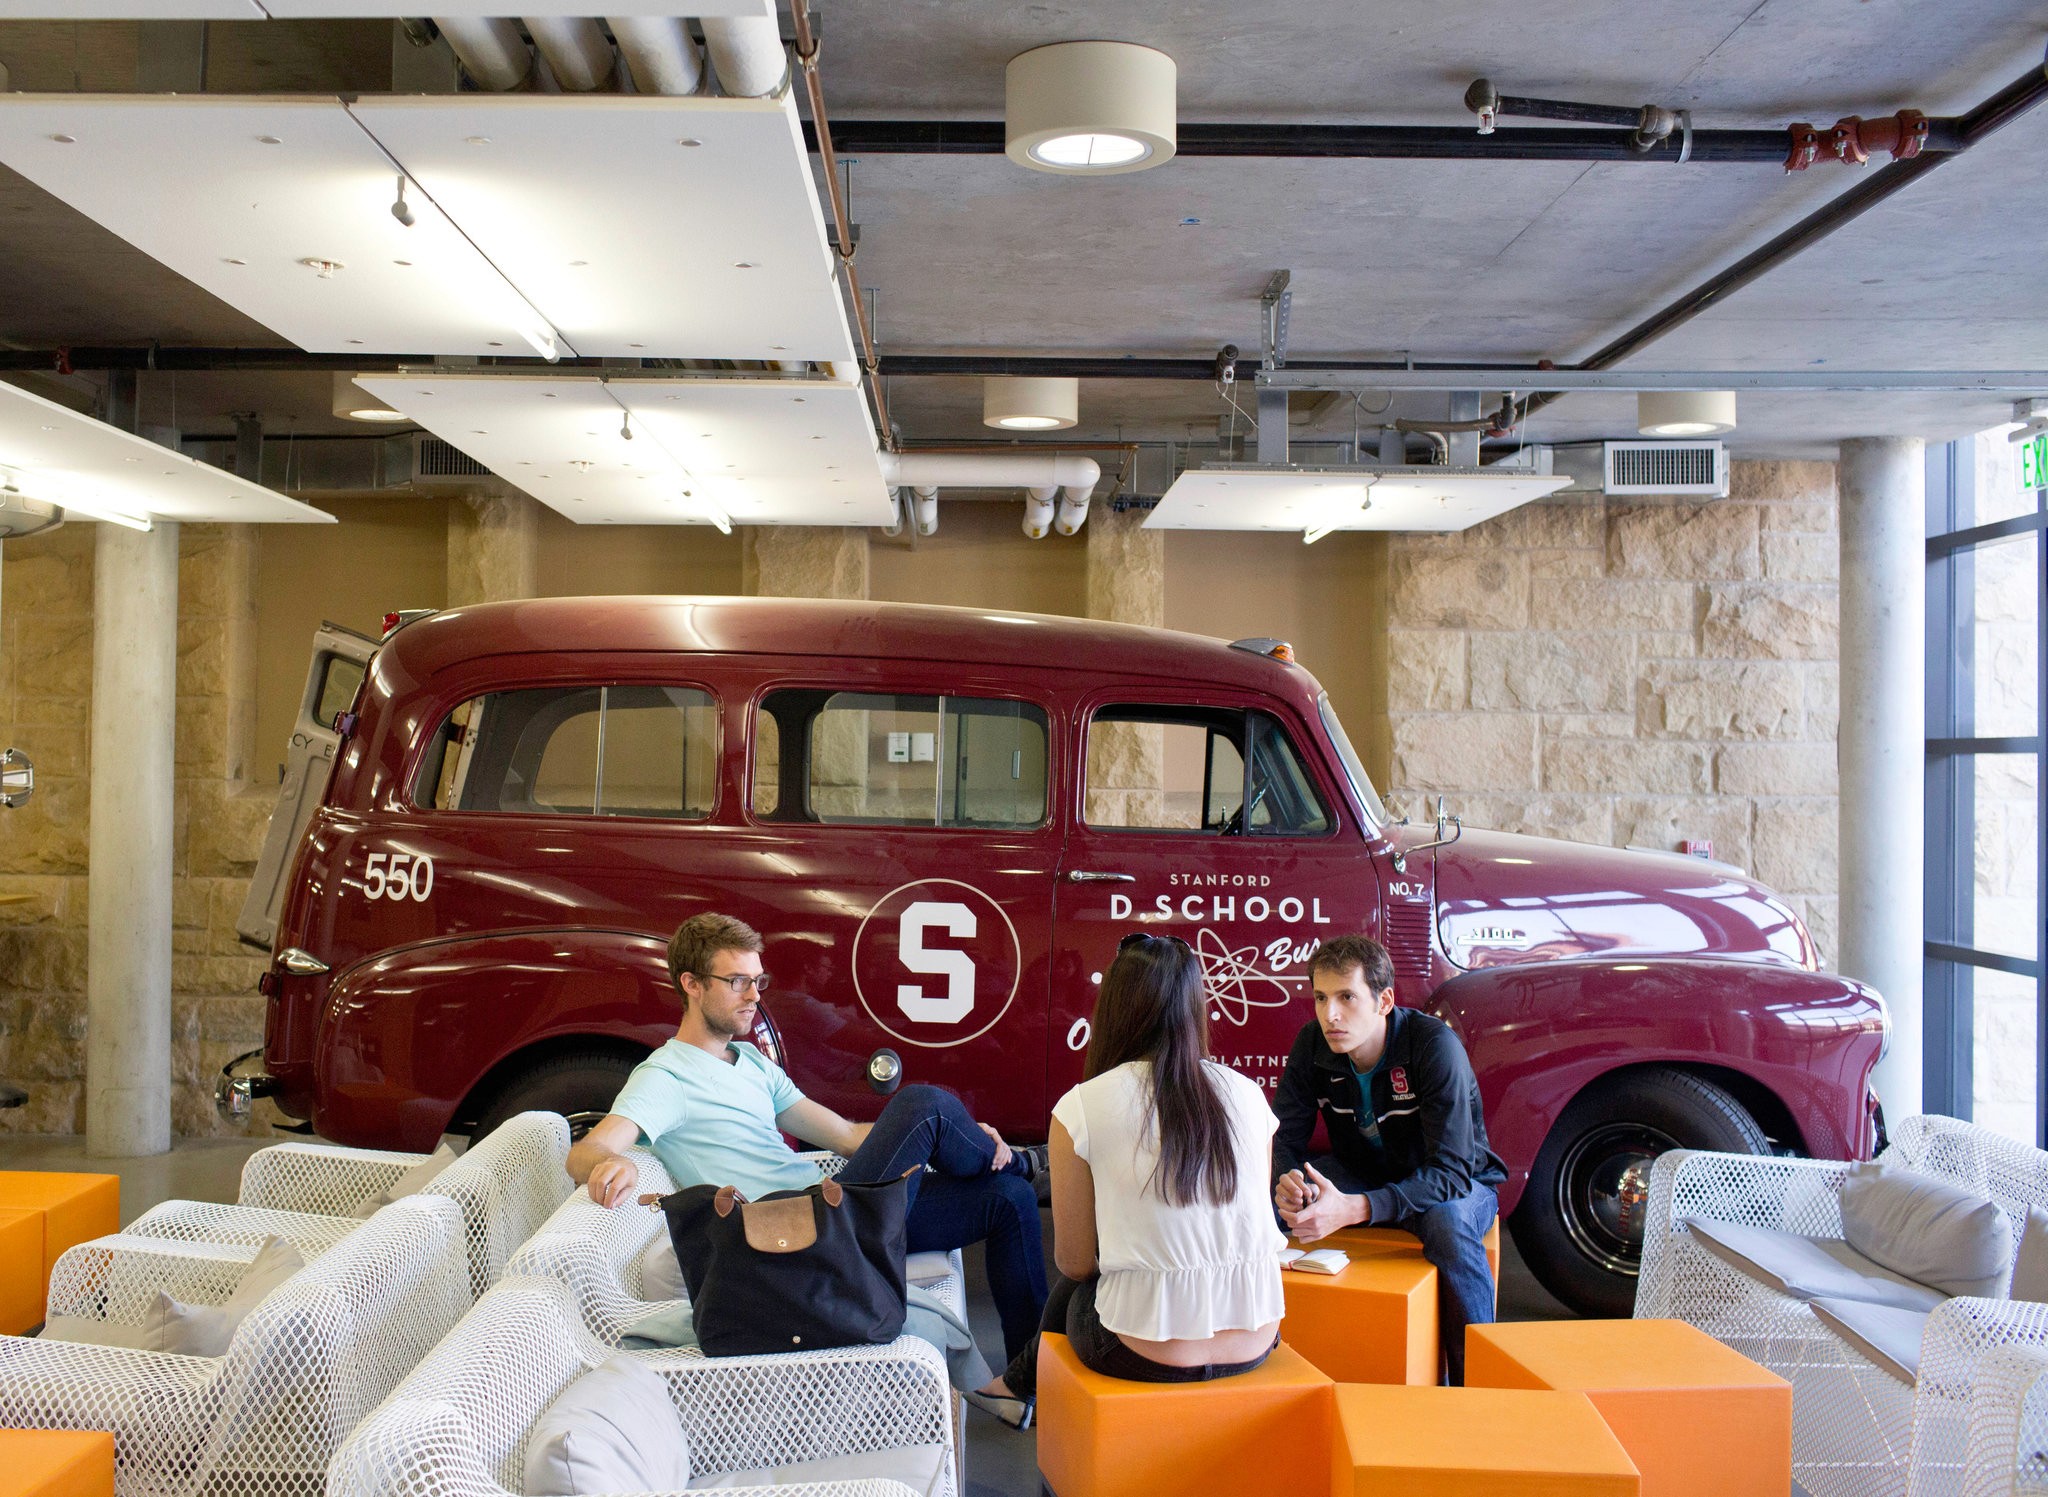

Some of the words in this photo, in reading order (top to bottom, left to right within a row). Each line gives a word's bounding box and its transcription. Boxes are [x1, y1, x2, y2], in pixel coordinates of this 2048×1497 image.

[2022, 436, 2048, 488] EXI
[363, 853, 434, 903] 550
[1170, 873, 1271, 887] STANFORD
[1389, 882, 1413, 896] NO.
[1414, 883, 1424, 896] 7
[897, 901, 977, 1024] S
[1210, 1055, 1290, 1068] PLATTNE
[1256, 1076, 1279, 1088] DE
[1390, 1066, 1409, 1094] S
